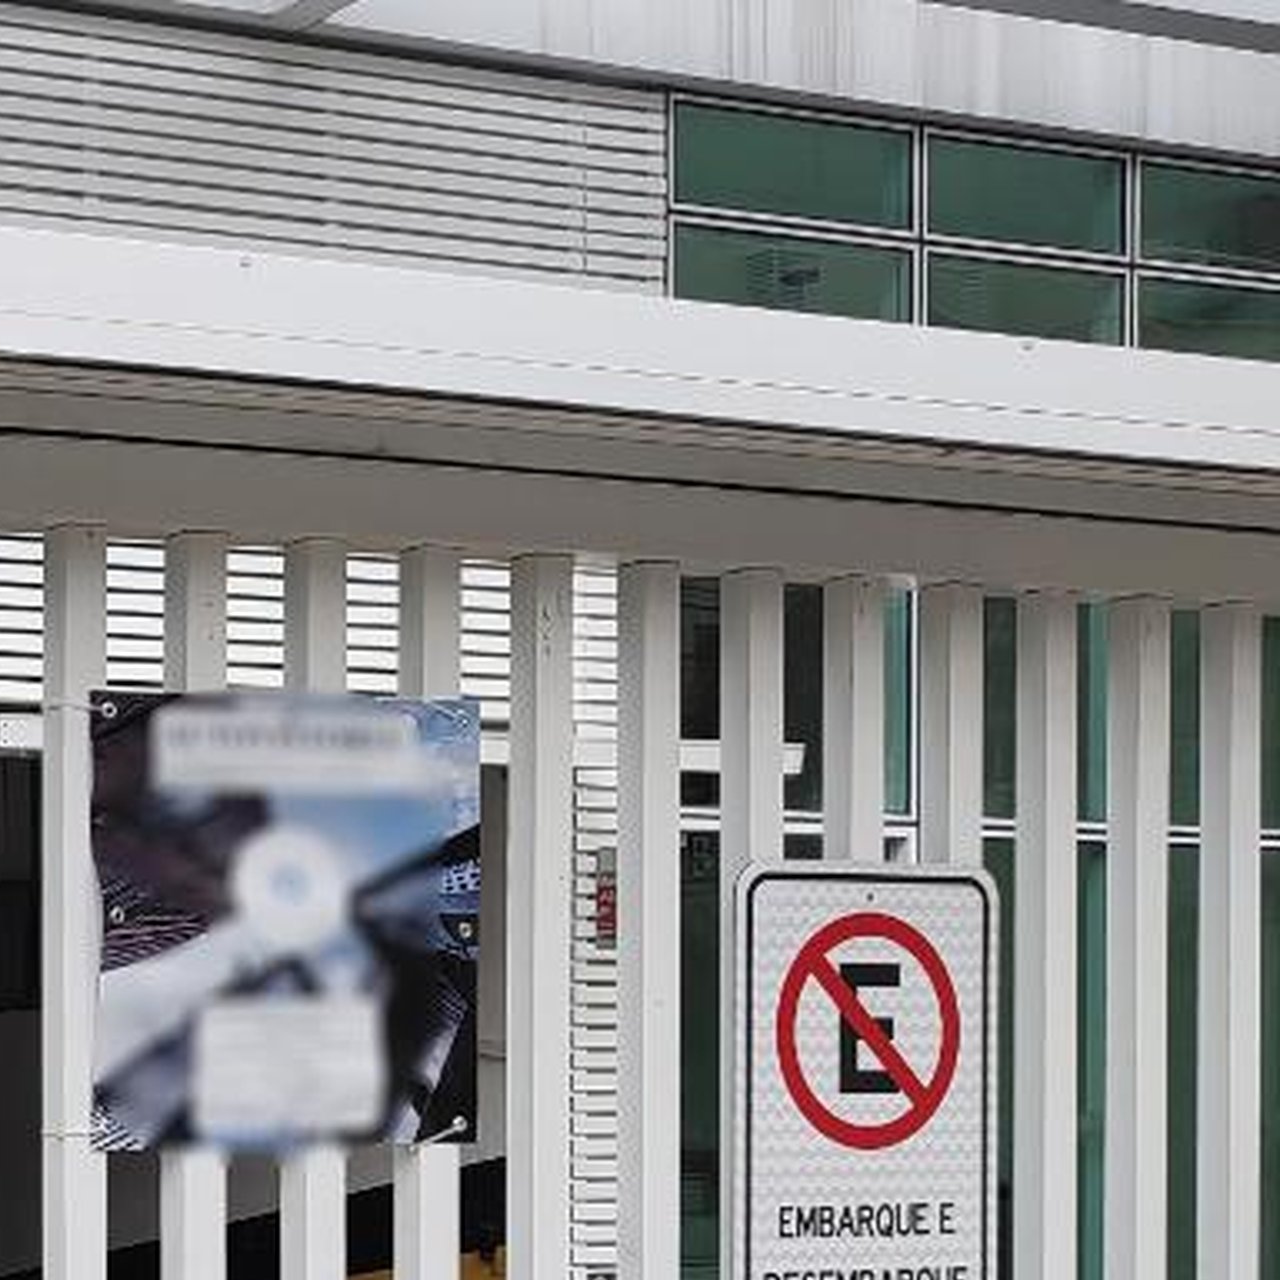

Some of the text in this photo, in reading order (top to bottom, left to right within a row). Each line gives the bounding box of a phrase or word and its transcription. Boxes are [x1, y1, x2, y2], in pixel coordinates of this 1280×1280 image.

[839, 963, 901, 1094] E
[778, 1203, 956, 1238] EMBARQUE E
